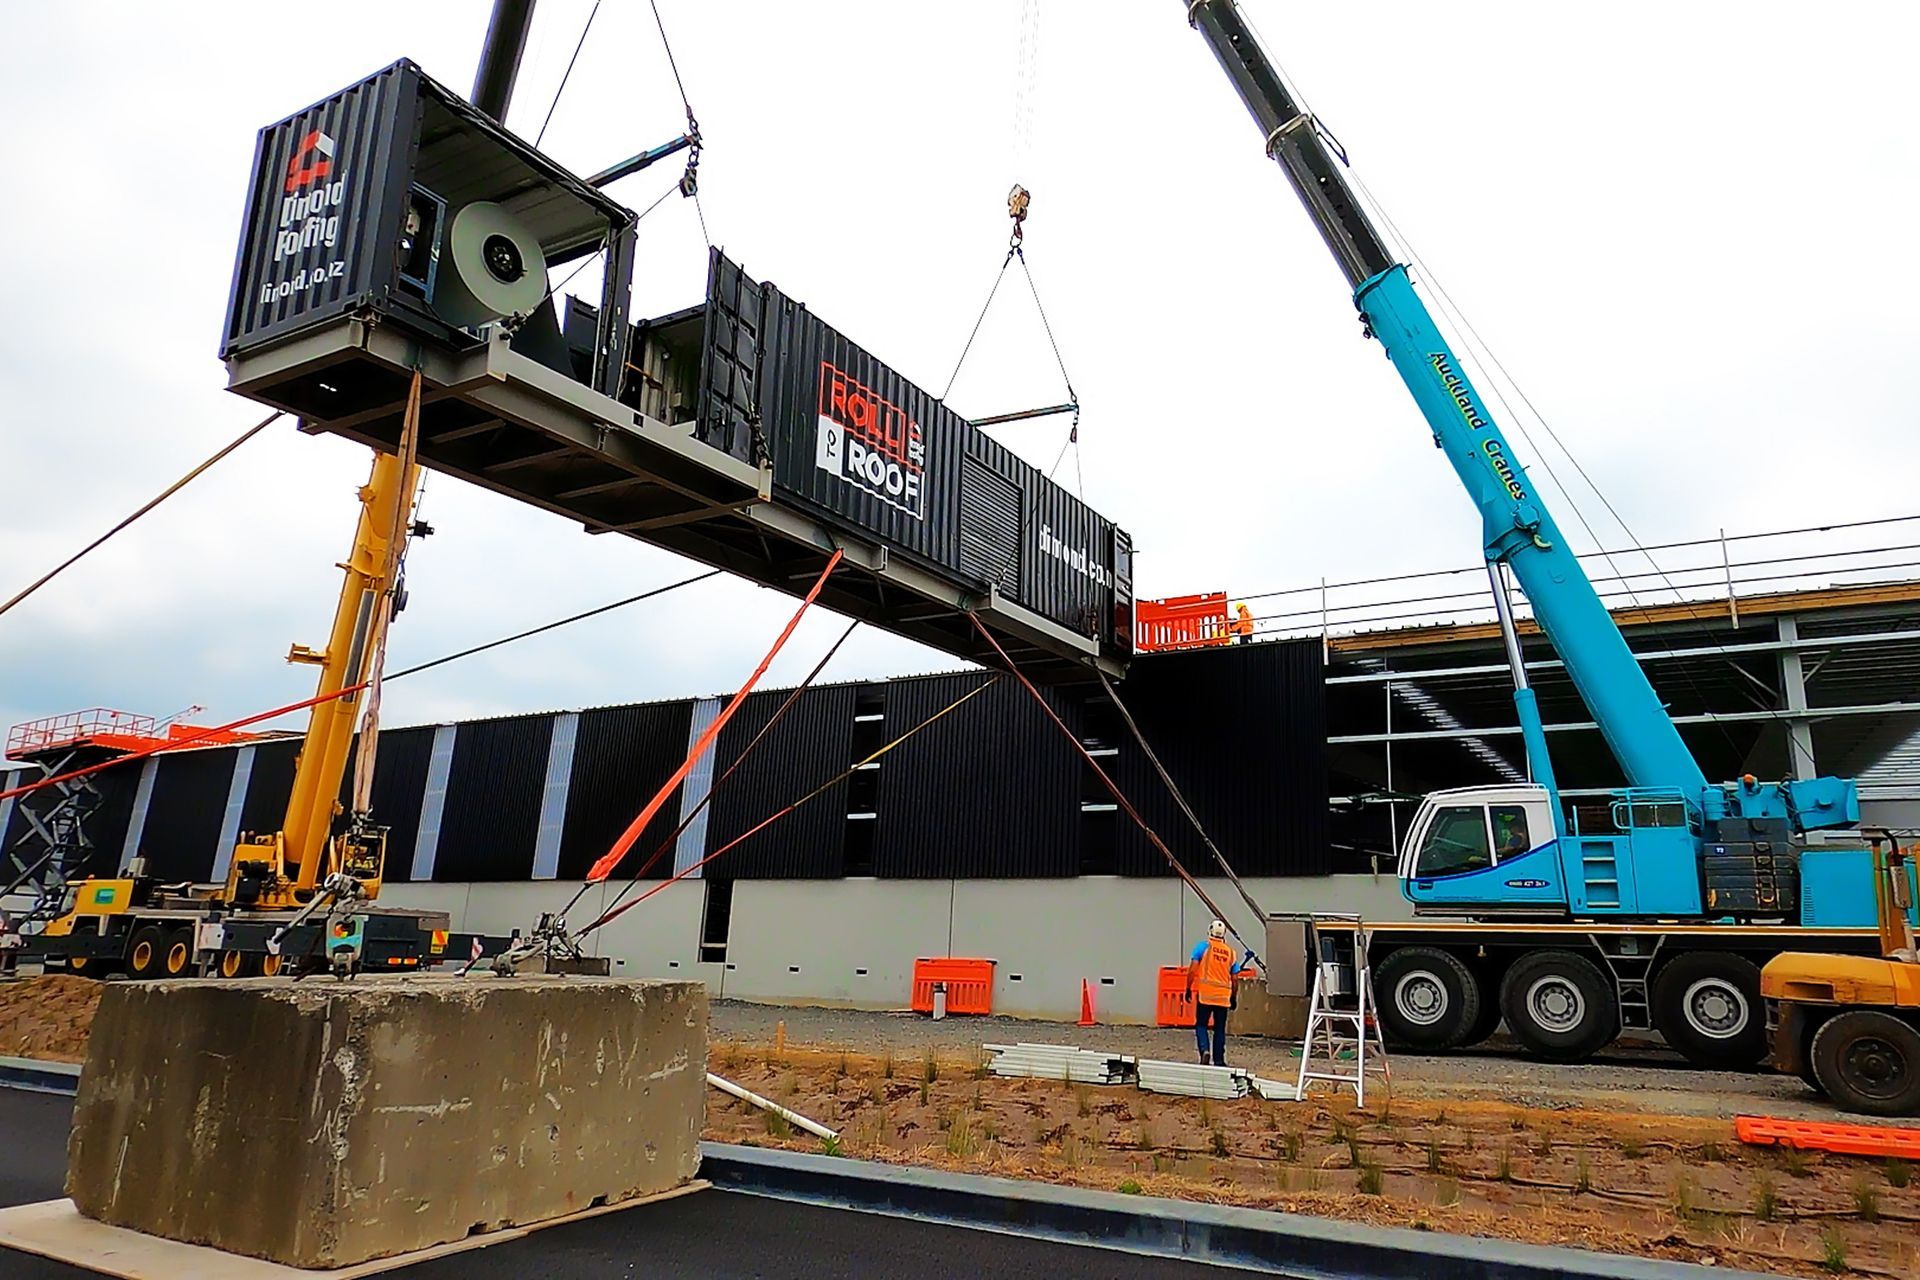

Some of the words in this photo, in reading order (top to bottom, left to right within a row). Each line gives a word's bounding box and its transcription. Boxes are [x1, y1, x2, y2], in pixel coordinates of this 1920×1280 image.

[826, 429, 837, 458] TO
[1428, 352, 1488, 431] Auckland
[1482, 439, 1527, 501] Cranes
[848, 439, 920, 501] ROOF
